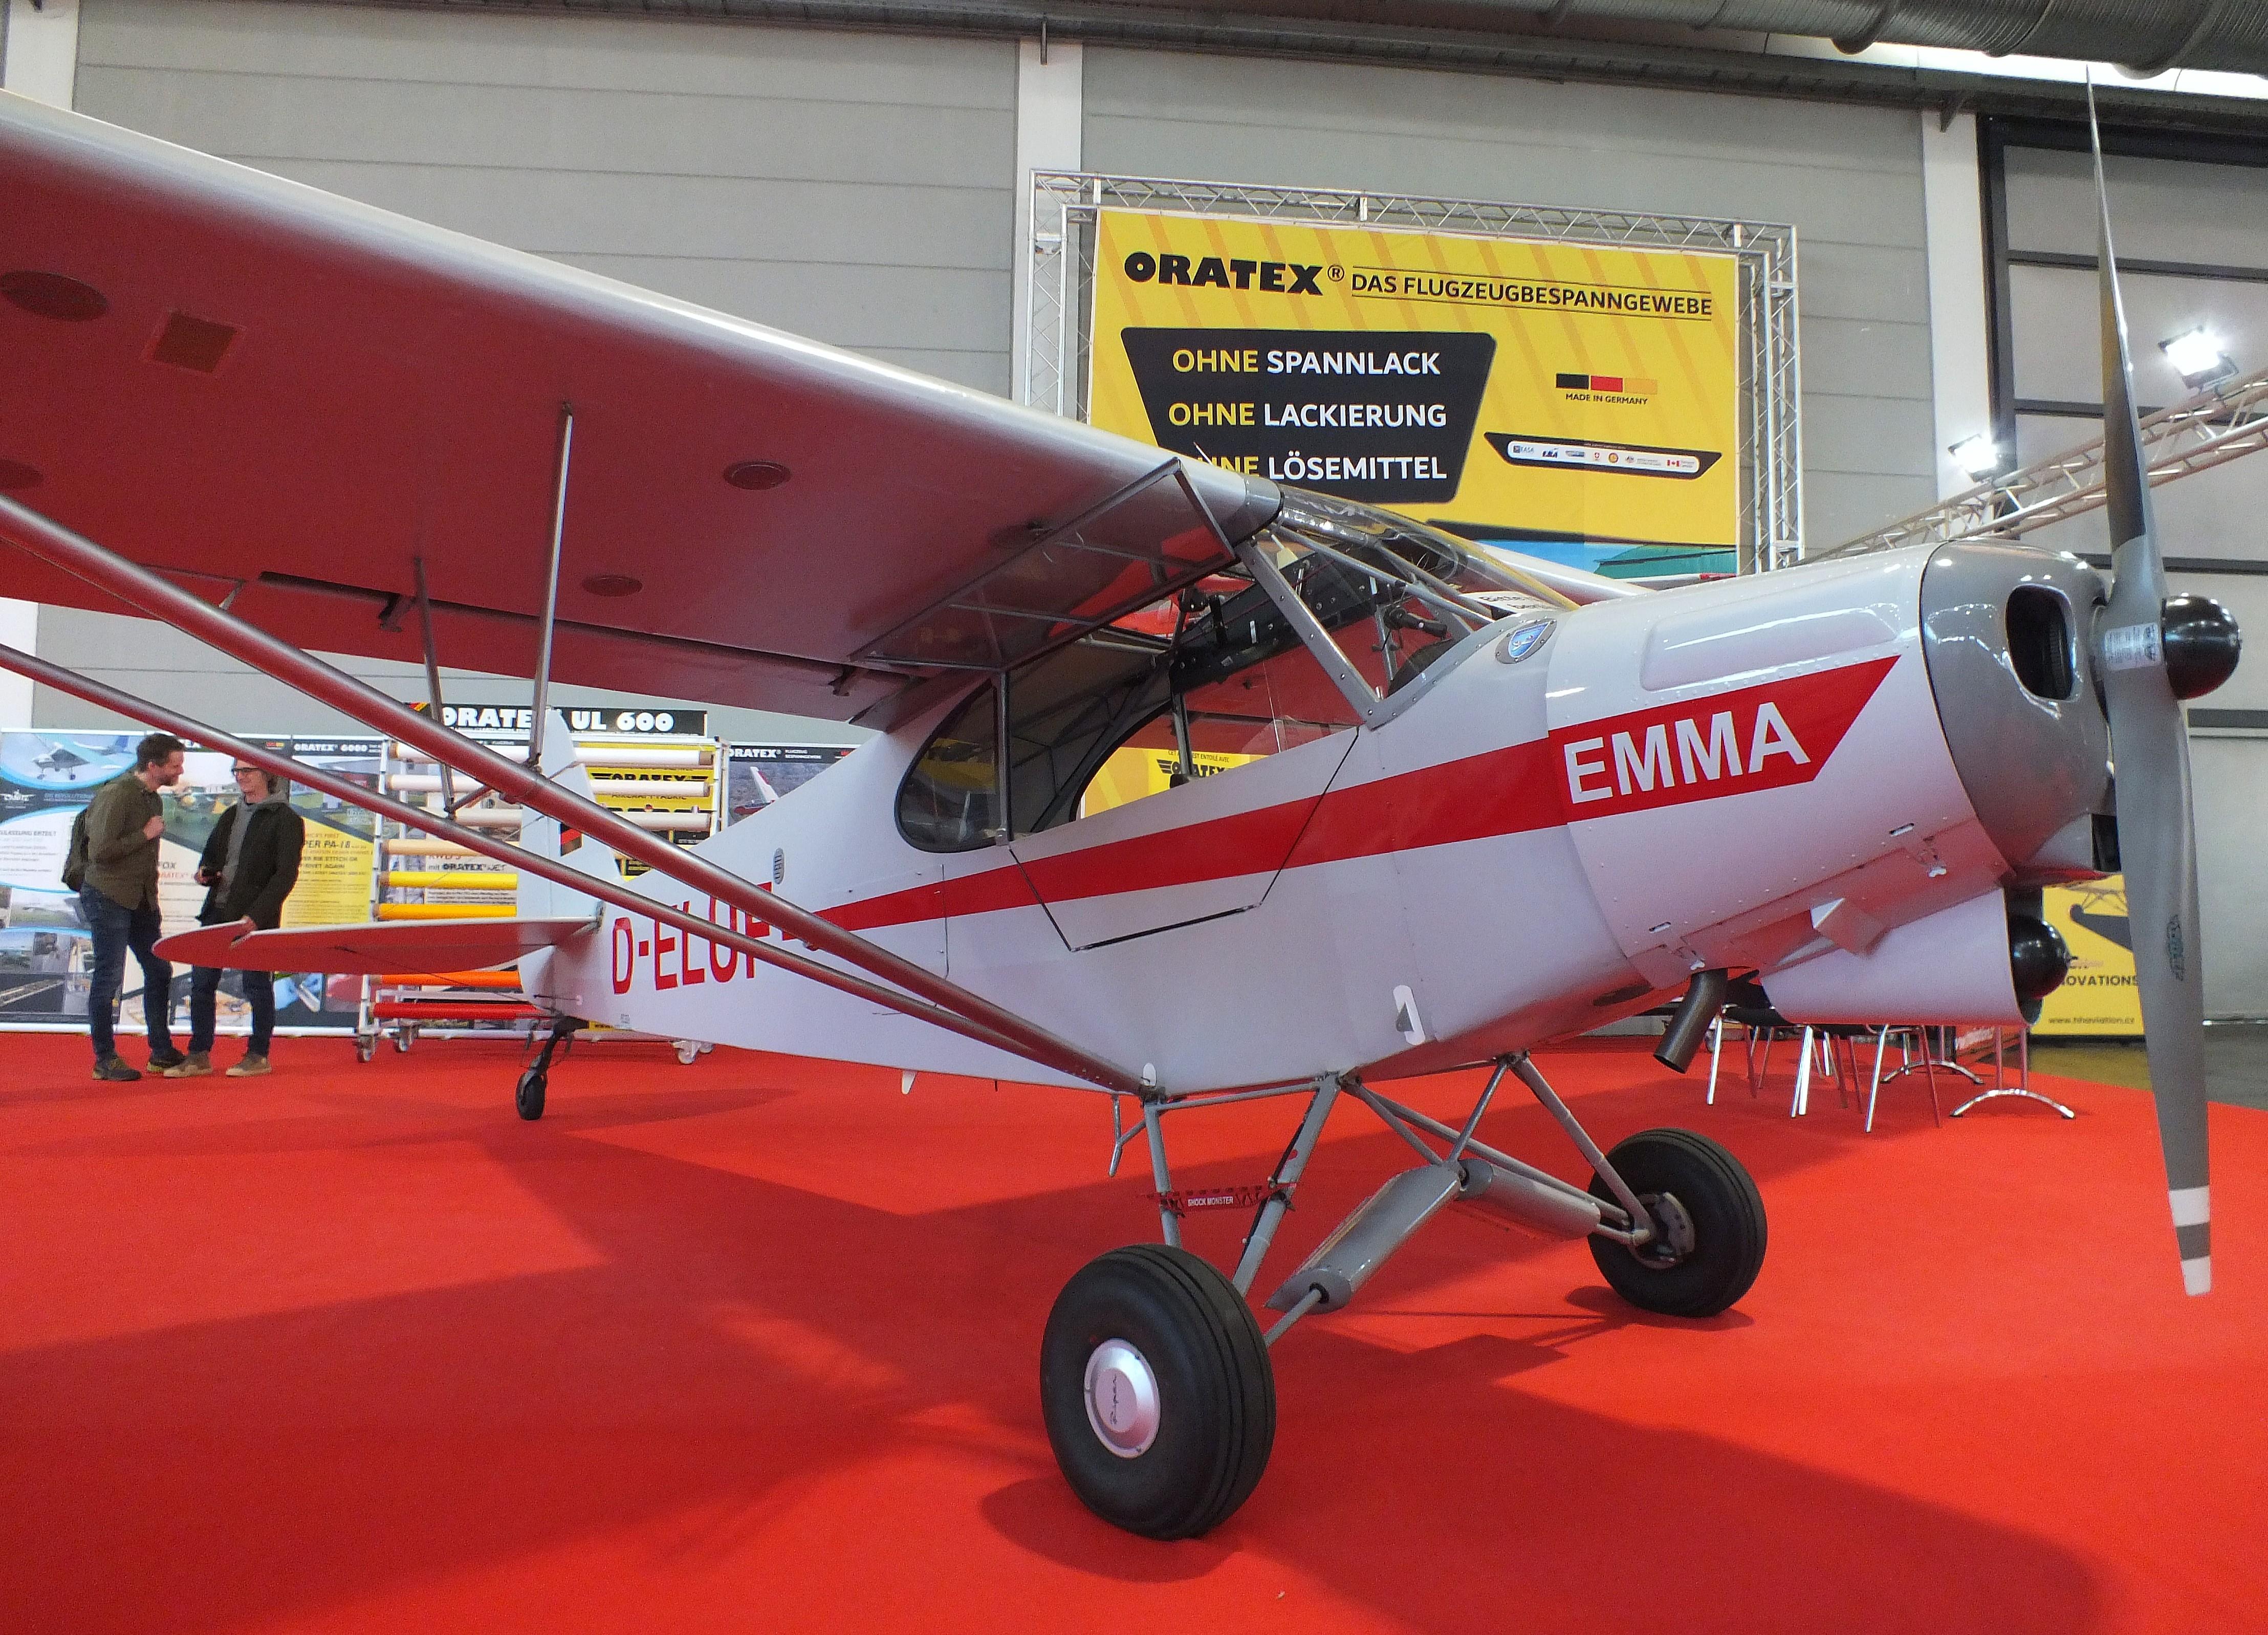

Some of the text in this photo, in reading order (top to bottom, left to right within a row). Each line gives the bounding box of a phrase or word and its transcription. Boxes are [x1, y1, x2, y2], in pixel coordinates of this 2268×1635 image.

[1351, 274, 1712, 316] DAS FLUGZEUGBESPANNGEWEBE
[1172, 350, 1441, 375] OHNE SPANNLACK
[1605, 396, 1648, 405] GERMANY
[1168, 402, 1447, 427] OHNE LACKIERUNG
[1269, 450, 1447, 480] LÖSEMITTEL
[443, 706, 674, 731] ORATE UL 600
[1563, 701, 1811, 804] EMMA
[2061, 975, 2139, 986] OVATIONS
[1188, 1196, 1233, 1207] SHOCK MONSTER
